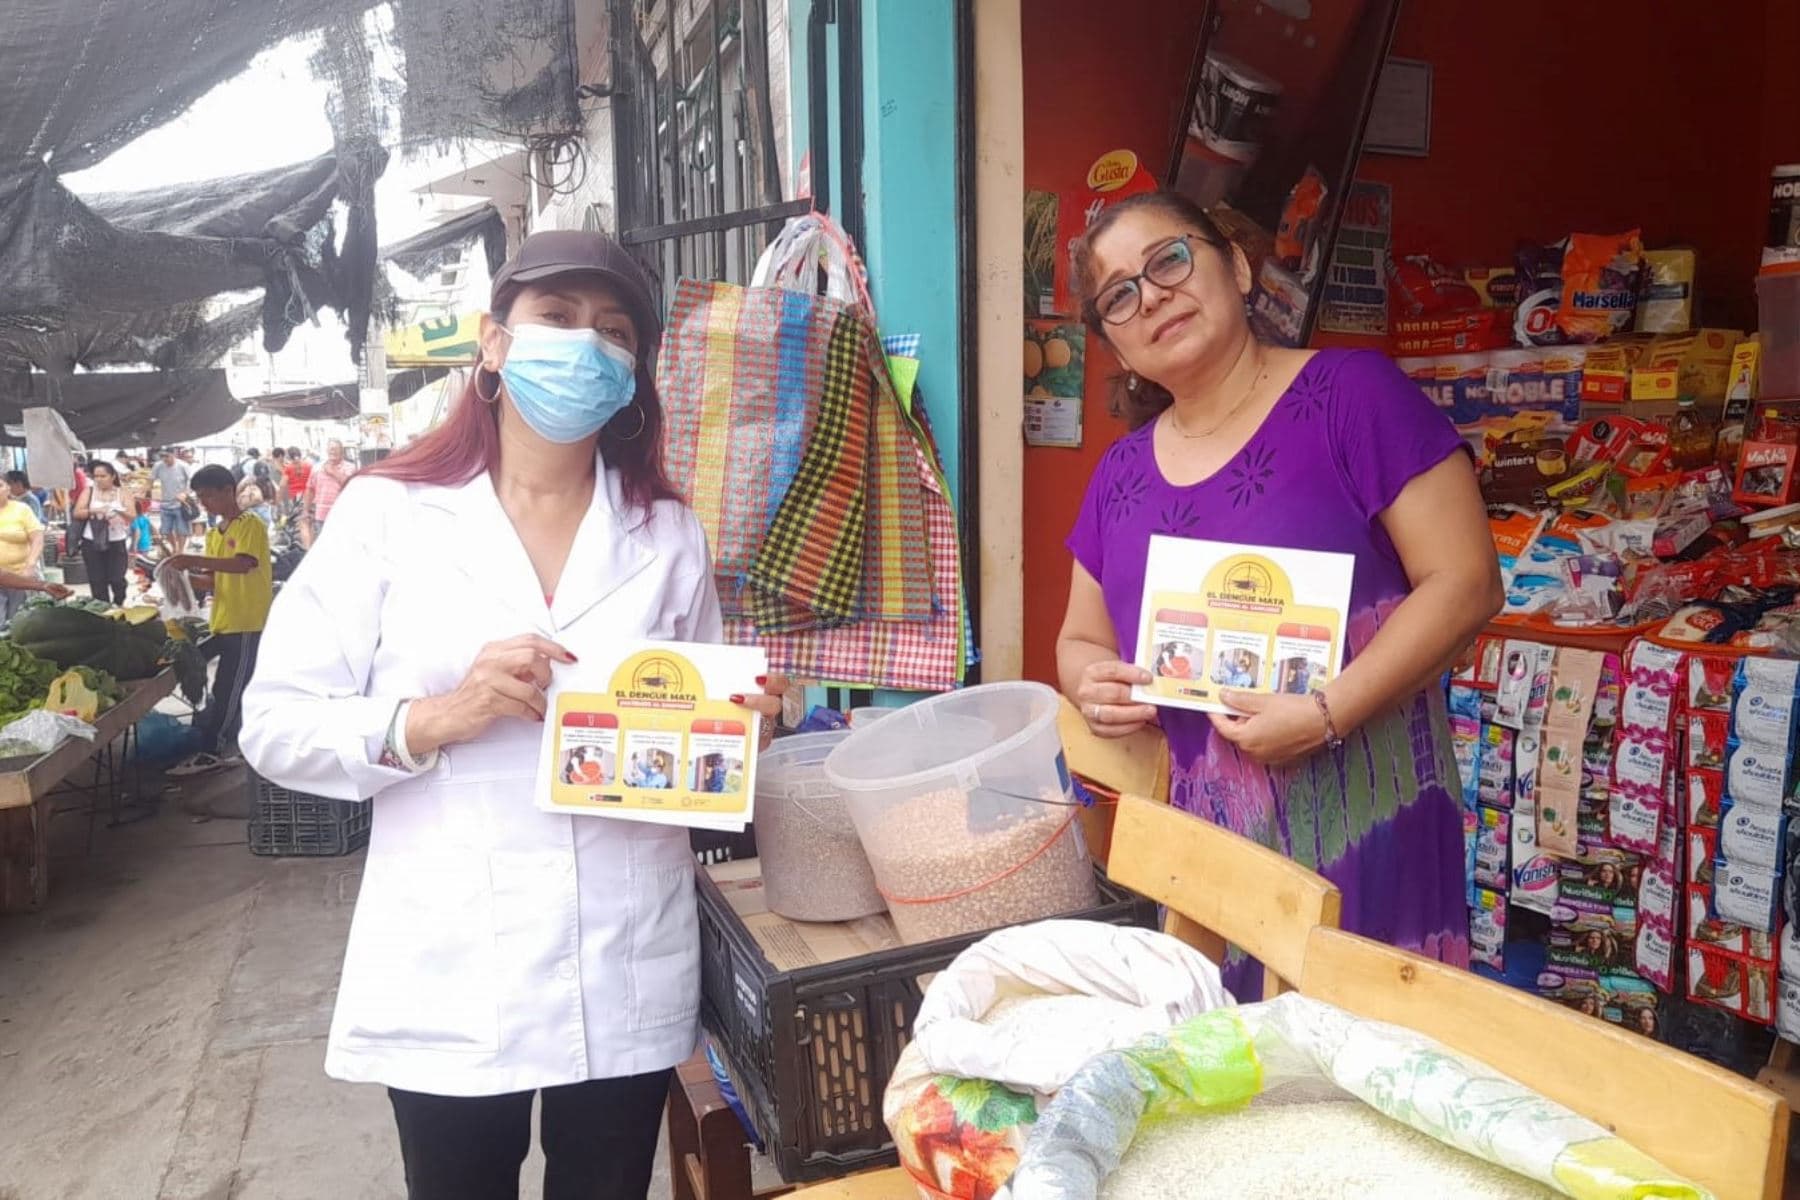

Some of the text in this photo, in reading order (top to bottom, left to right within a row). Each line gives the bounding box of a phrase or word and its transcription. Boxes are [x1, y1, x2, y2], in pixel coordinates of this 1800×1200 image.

[1573, 291, 1637, 309] Marsella
[1492, 378, 1565, 405] NOBLE
[1219, 592, 1257, 602] DENGUE
[1258, 597, 1285, 606] MATA
[615, 690, 697, 701] EL DENGUE MATA
[1513, 860, 1559, 889] Vanish
